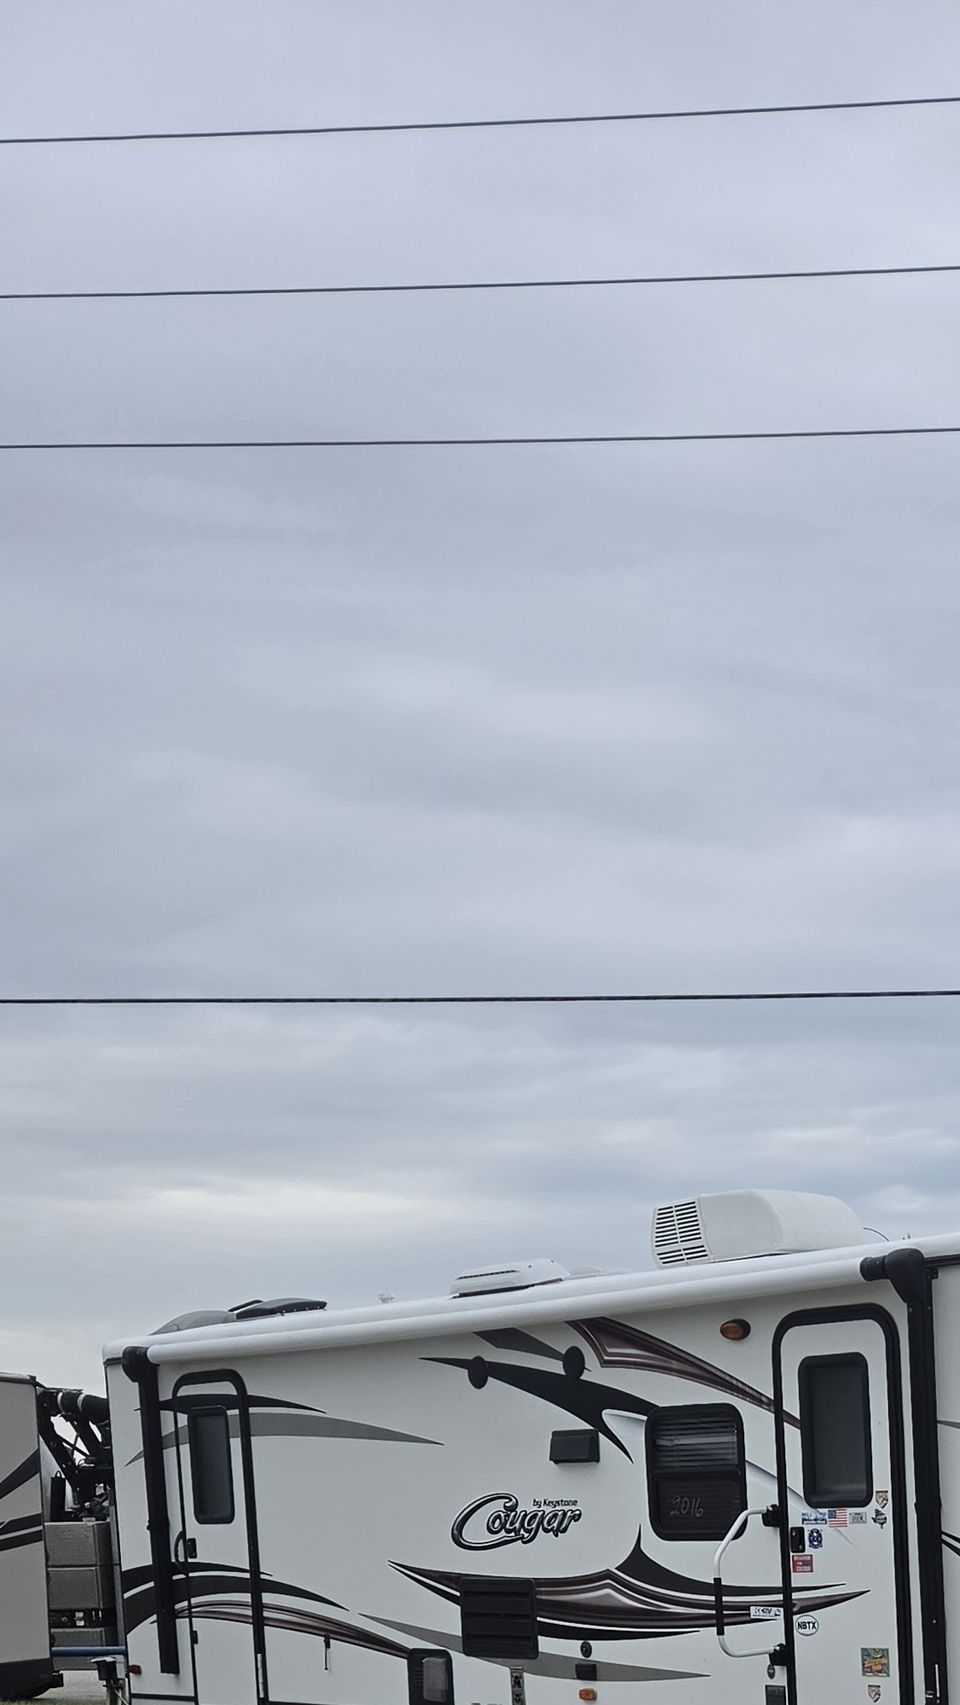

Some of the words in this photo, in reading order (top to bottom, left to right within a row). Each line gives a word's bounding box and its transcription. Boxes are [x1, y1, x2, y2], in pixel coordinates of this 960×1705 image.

[532, 1498, 543, 1509] by
[543, 1498, 578, 1509] Keystone
[670, 1495, 704, 1518] 2016
[451, 1492, 582, 1551] Cougar
[797, 1621, 817, 1631] NBTX
